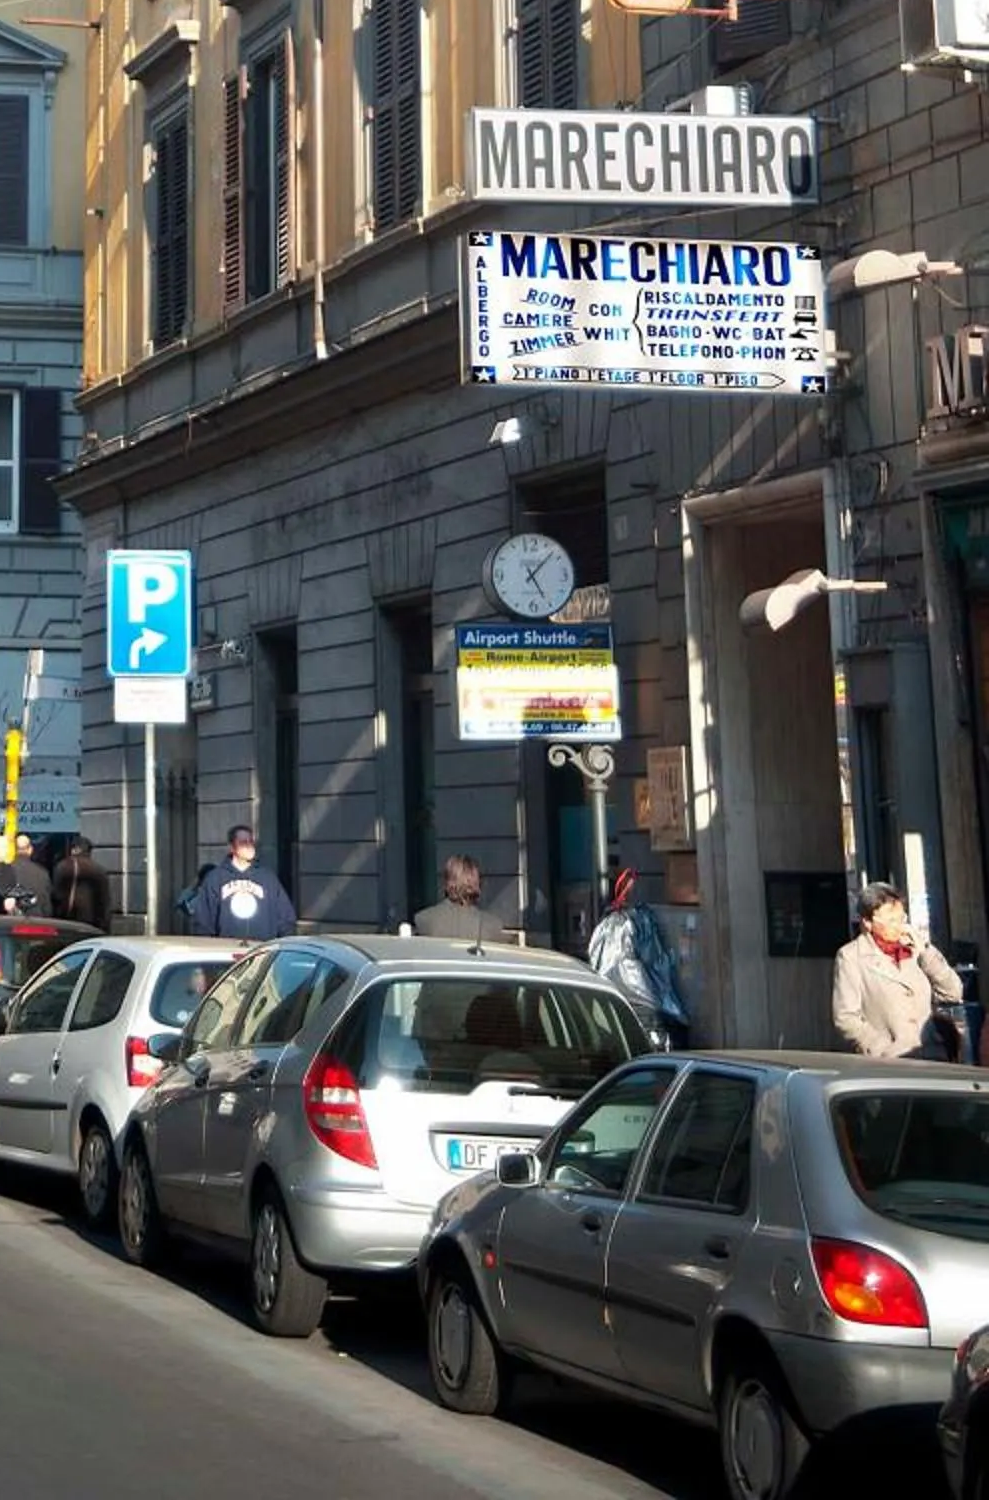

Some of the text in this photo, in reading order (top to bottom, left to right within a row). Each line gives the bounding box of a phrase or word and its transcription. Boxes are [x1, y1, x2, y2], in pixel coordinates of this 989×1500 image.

[480, 119, 812, 196] MARECHIARO
[501, 234, 791, 286] MARECHIARO
[476, 256, 490, 357] ALBERGO
[526, 288, 575, 312] ROOM
[644, 291, 784, 306] RISCALDAMENTO
[589, 303, 622, 316] CON
[646, 308, 783, 322] TRANSFERT
[503, 312, 572, 327] CAMERE
[583, 327, 630, 340] WHIT
[712, 326, 742, 340] WC
[509, 331, 577, 356] ZIMMER
[128, 564, 179, 623] P
[464, 629, 577, 647] Airport Shuttle
